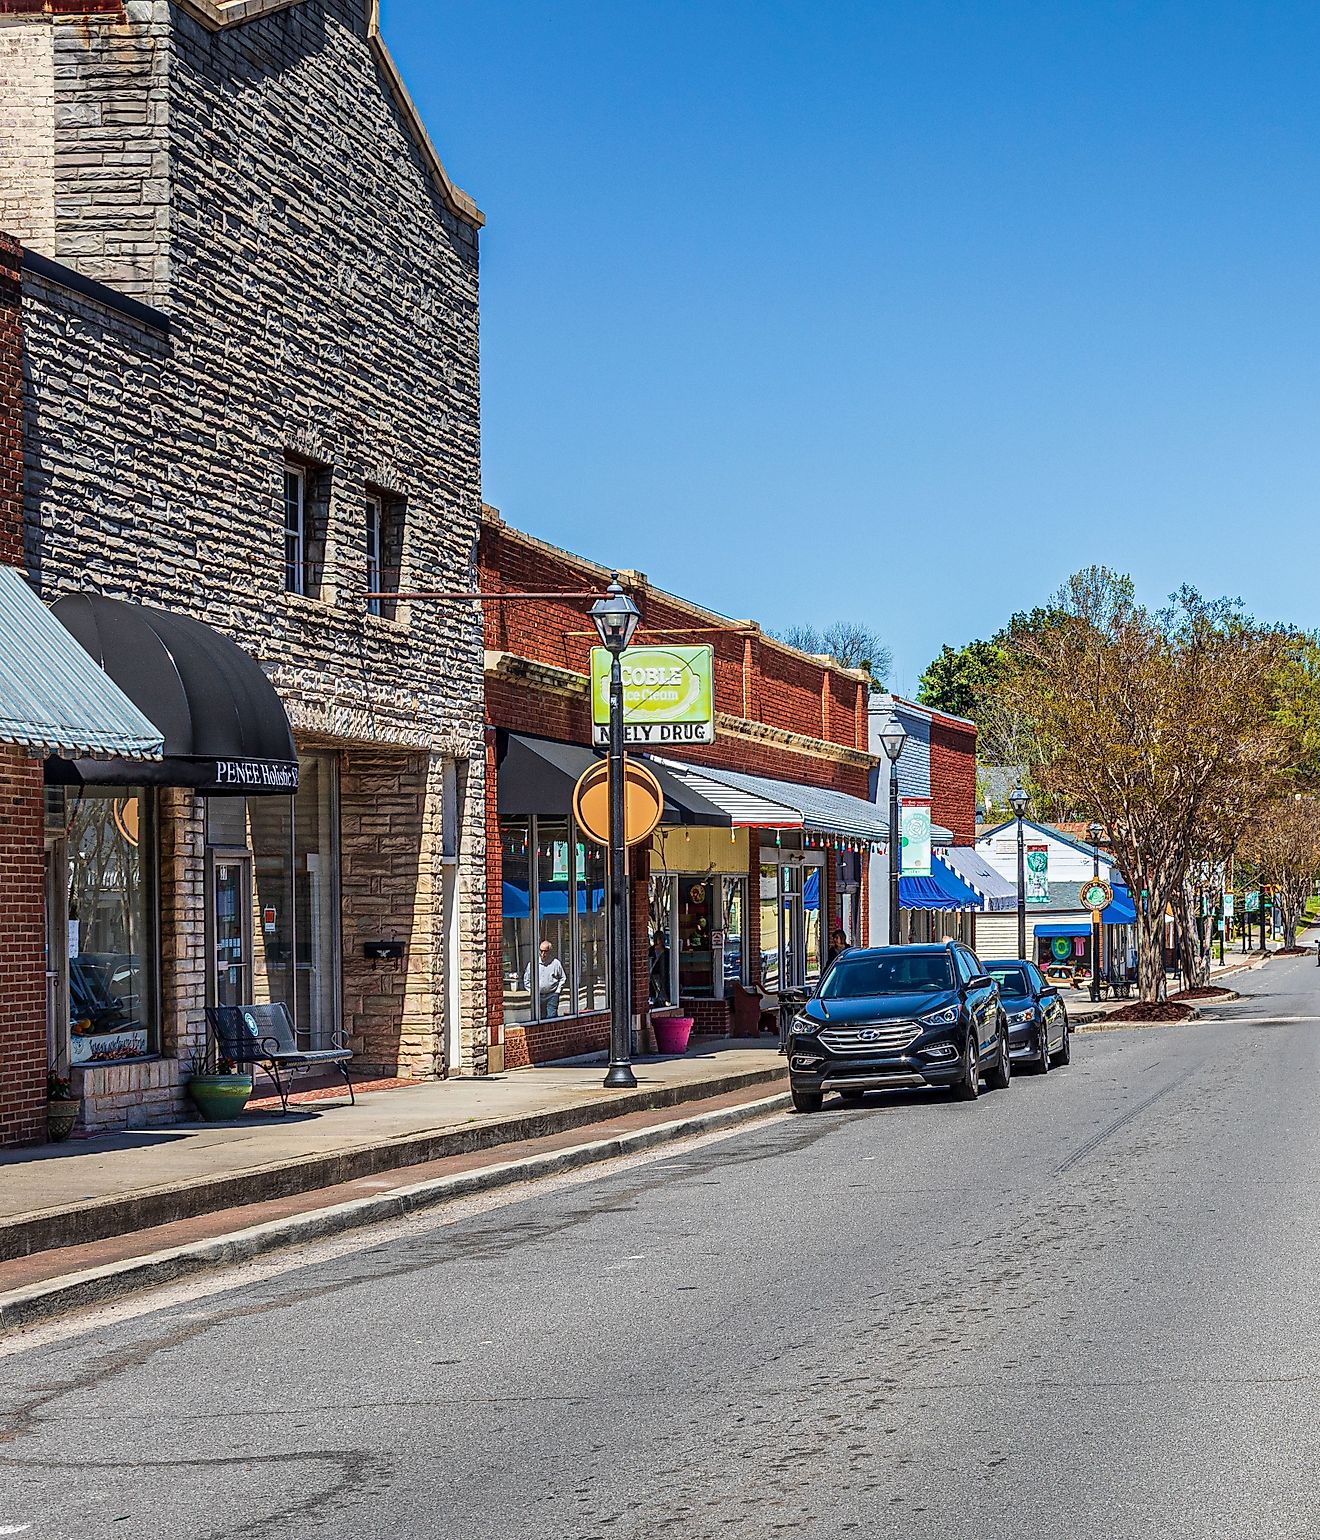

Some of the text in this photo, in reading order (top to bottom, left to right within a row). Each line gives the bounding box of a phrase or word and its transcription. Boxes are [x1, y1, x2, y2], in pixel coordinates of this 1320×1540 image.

[620, 667, 682, 687] COBLE
[641, 688, 679, 701] Cream
[600, 724, 705, 741] NELY DRUG
[215, 761, 261, 784] PENEE
[260, 763, 292, 787] Holistic
